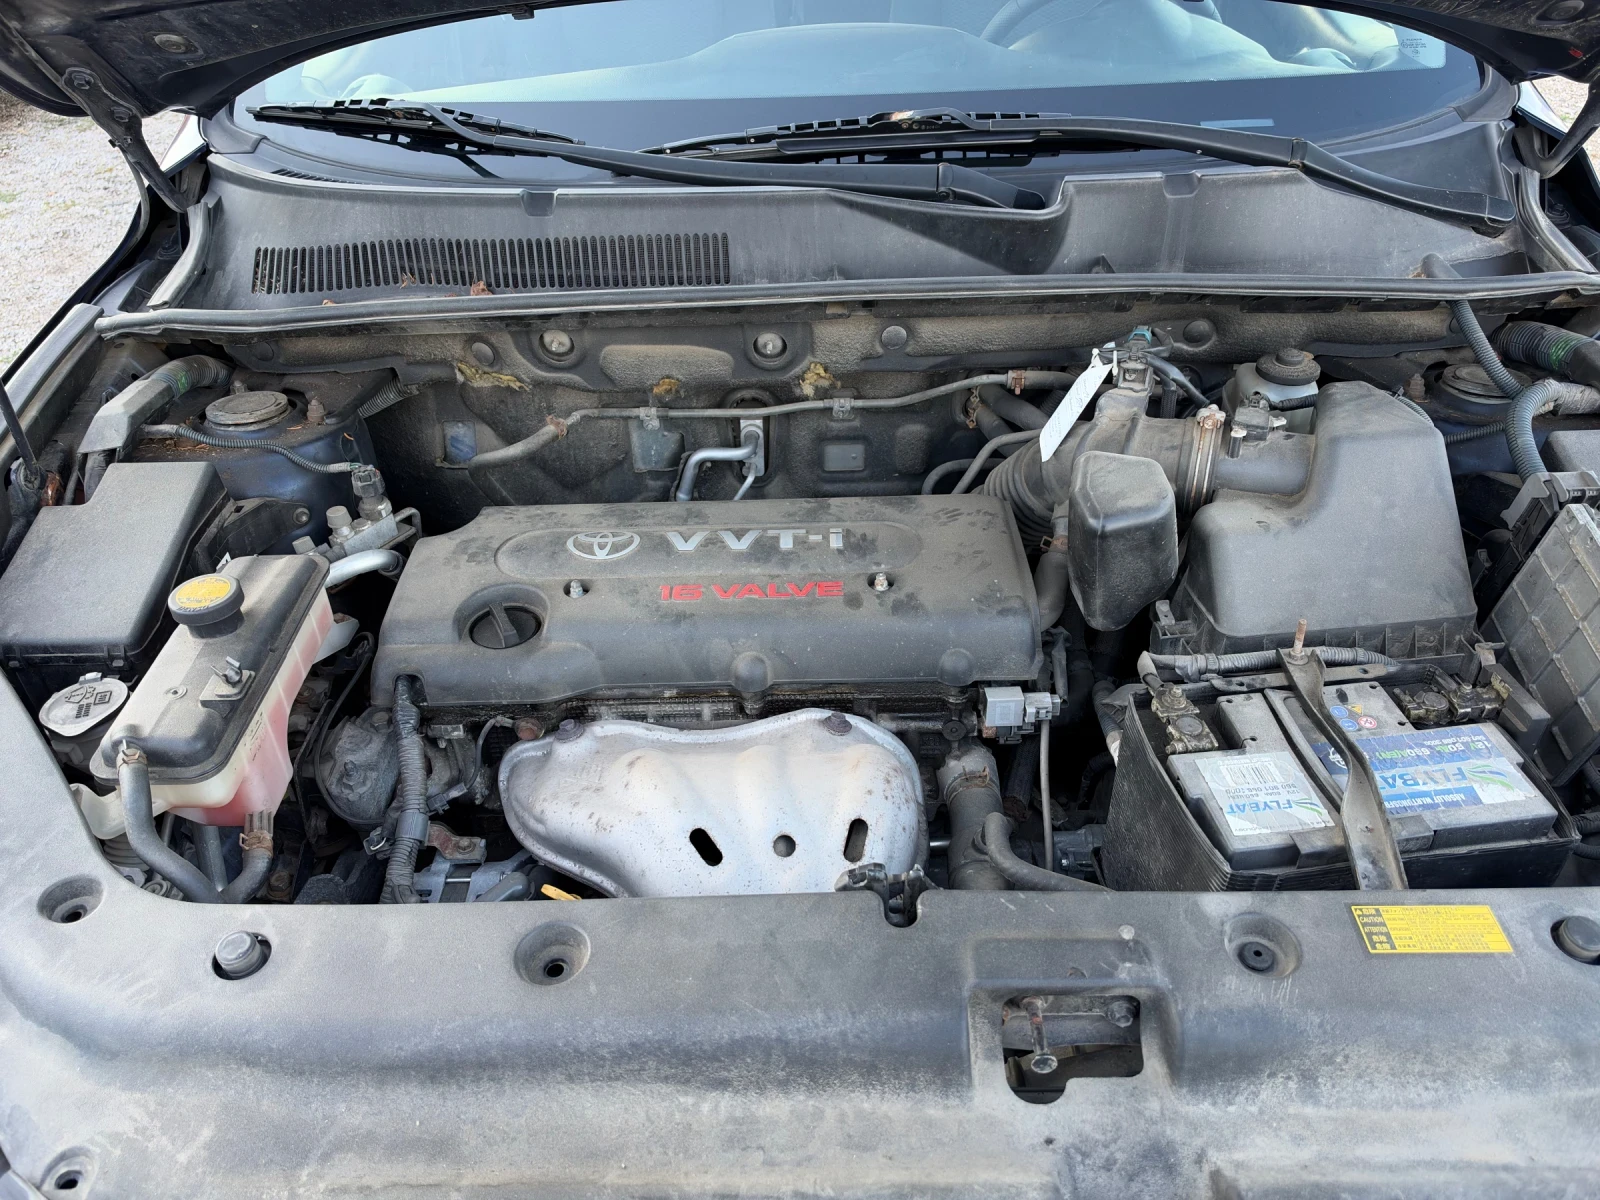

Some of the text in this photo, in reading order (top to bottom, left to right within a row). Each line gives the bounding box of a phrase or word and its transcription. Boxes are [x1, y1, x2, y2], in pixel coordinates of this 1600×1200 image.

[665, 528, 844, 552] VVT-i
[659, 581, 845, 602] 16 VALVE
[1469, 741, 1492, 750] 12V
[1433, 793, 1466, 803] ABSOLUT
[1226, 799, 1293, 814] FLYBAT
